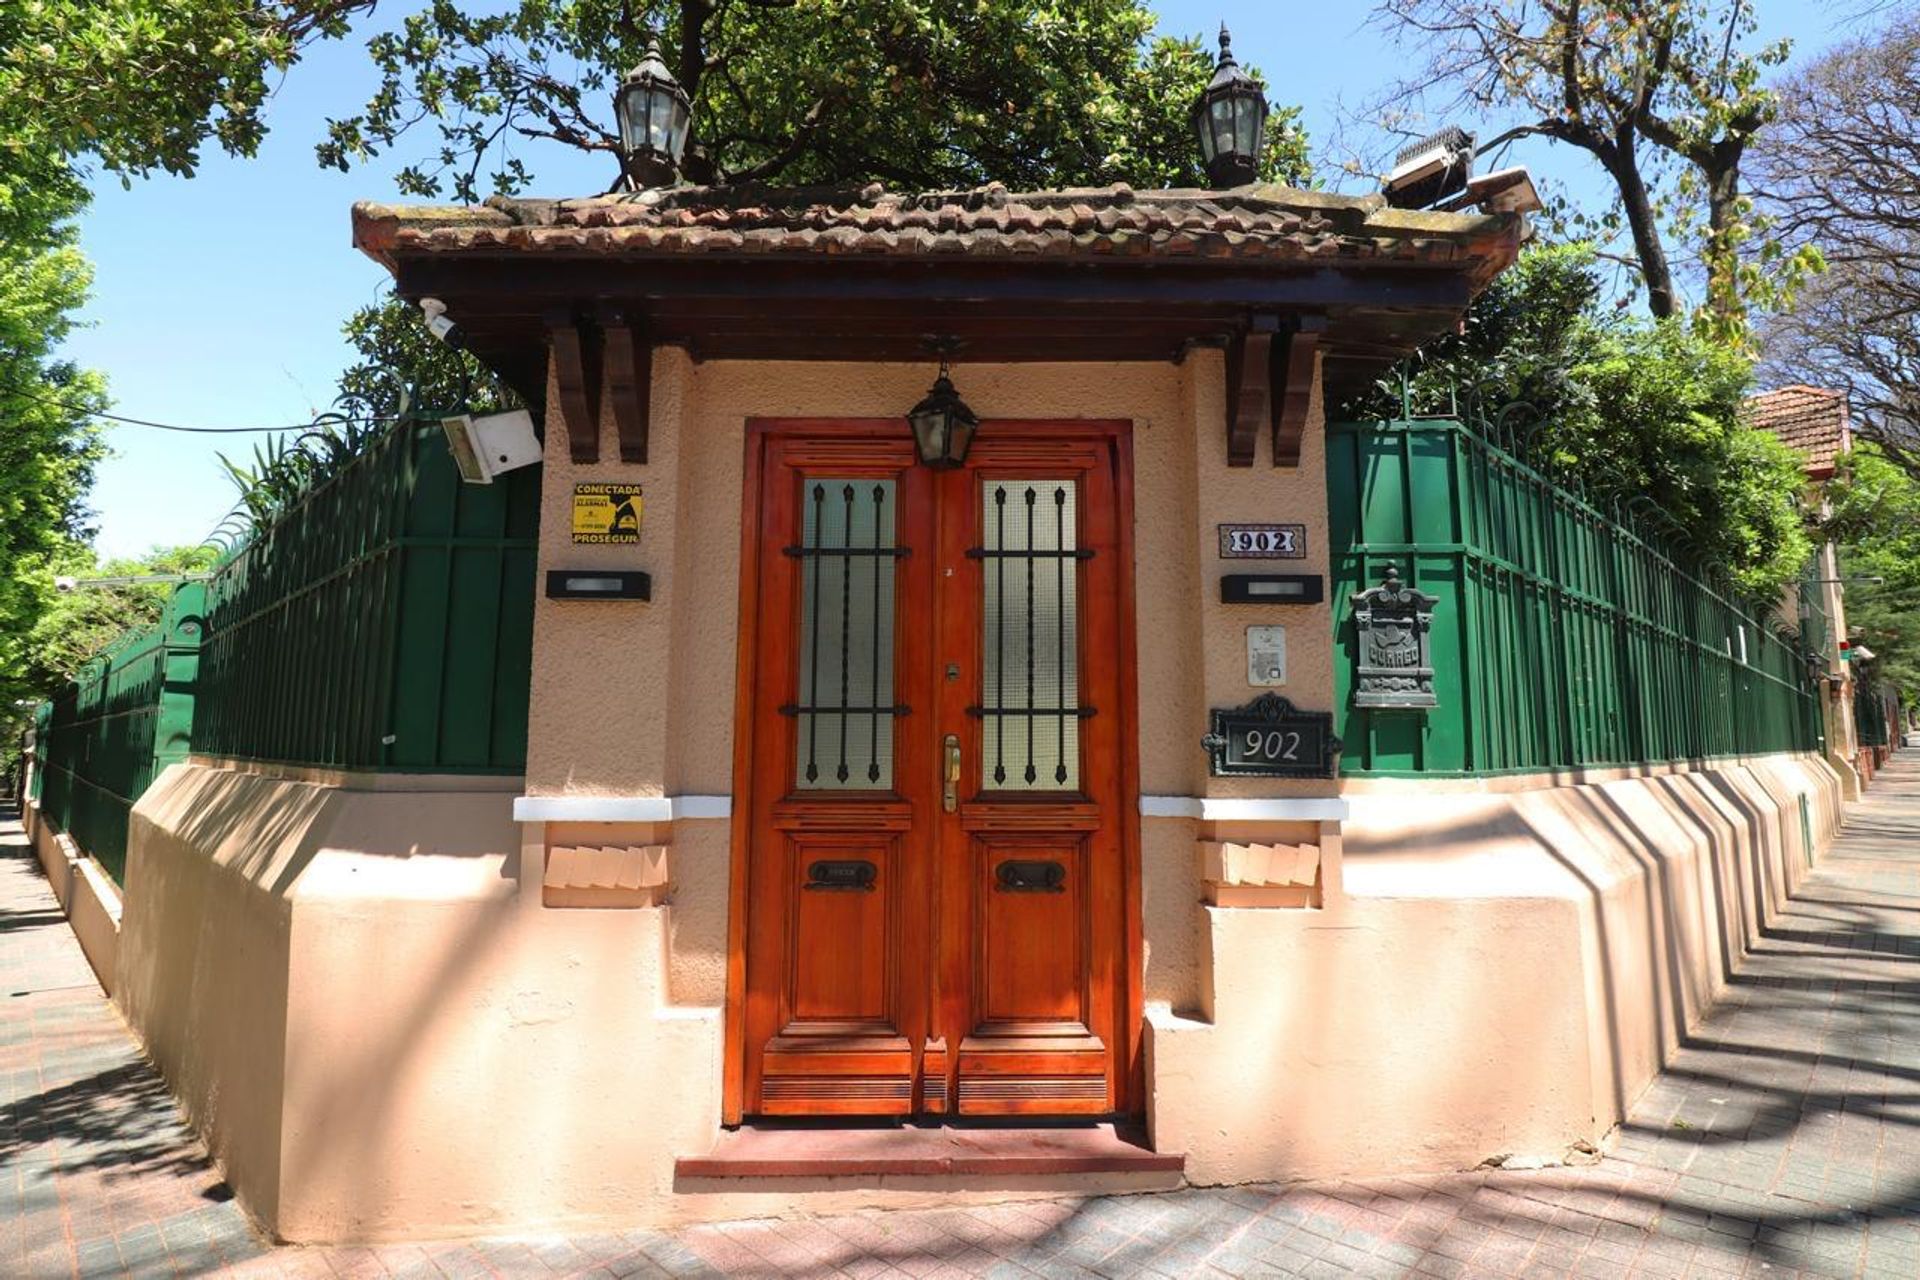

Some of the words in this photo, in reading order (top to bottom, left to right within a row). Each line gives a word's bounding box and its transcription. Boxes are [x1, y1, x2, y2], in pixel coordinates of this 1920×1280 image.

[577, 485, 640, 495] CONECTADA
[574, 534, 638, 543] PROSEGUR
[1239, 532, 1286, 550] 902
[1369, 645, 1419, 668] CORREO
[1242, 730, 1300, 760] 902
